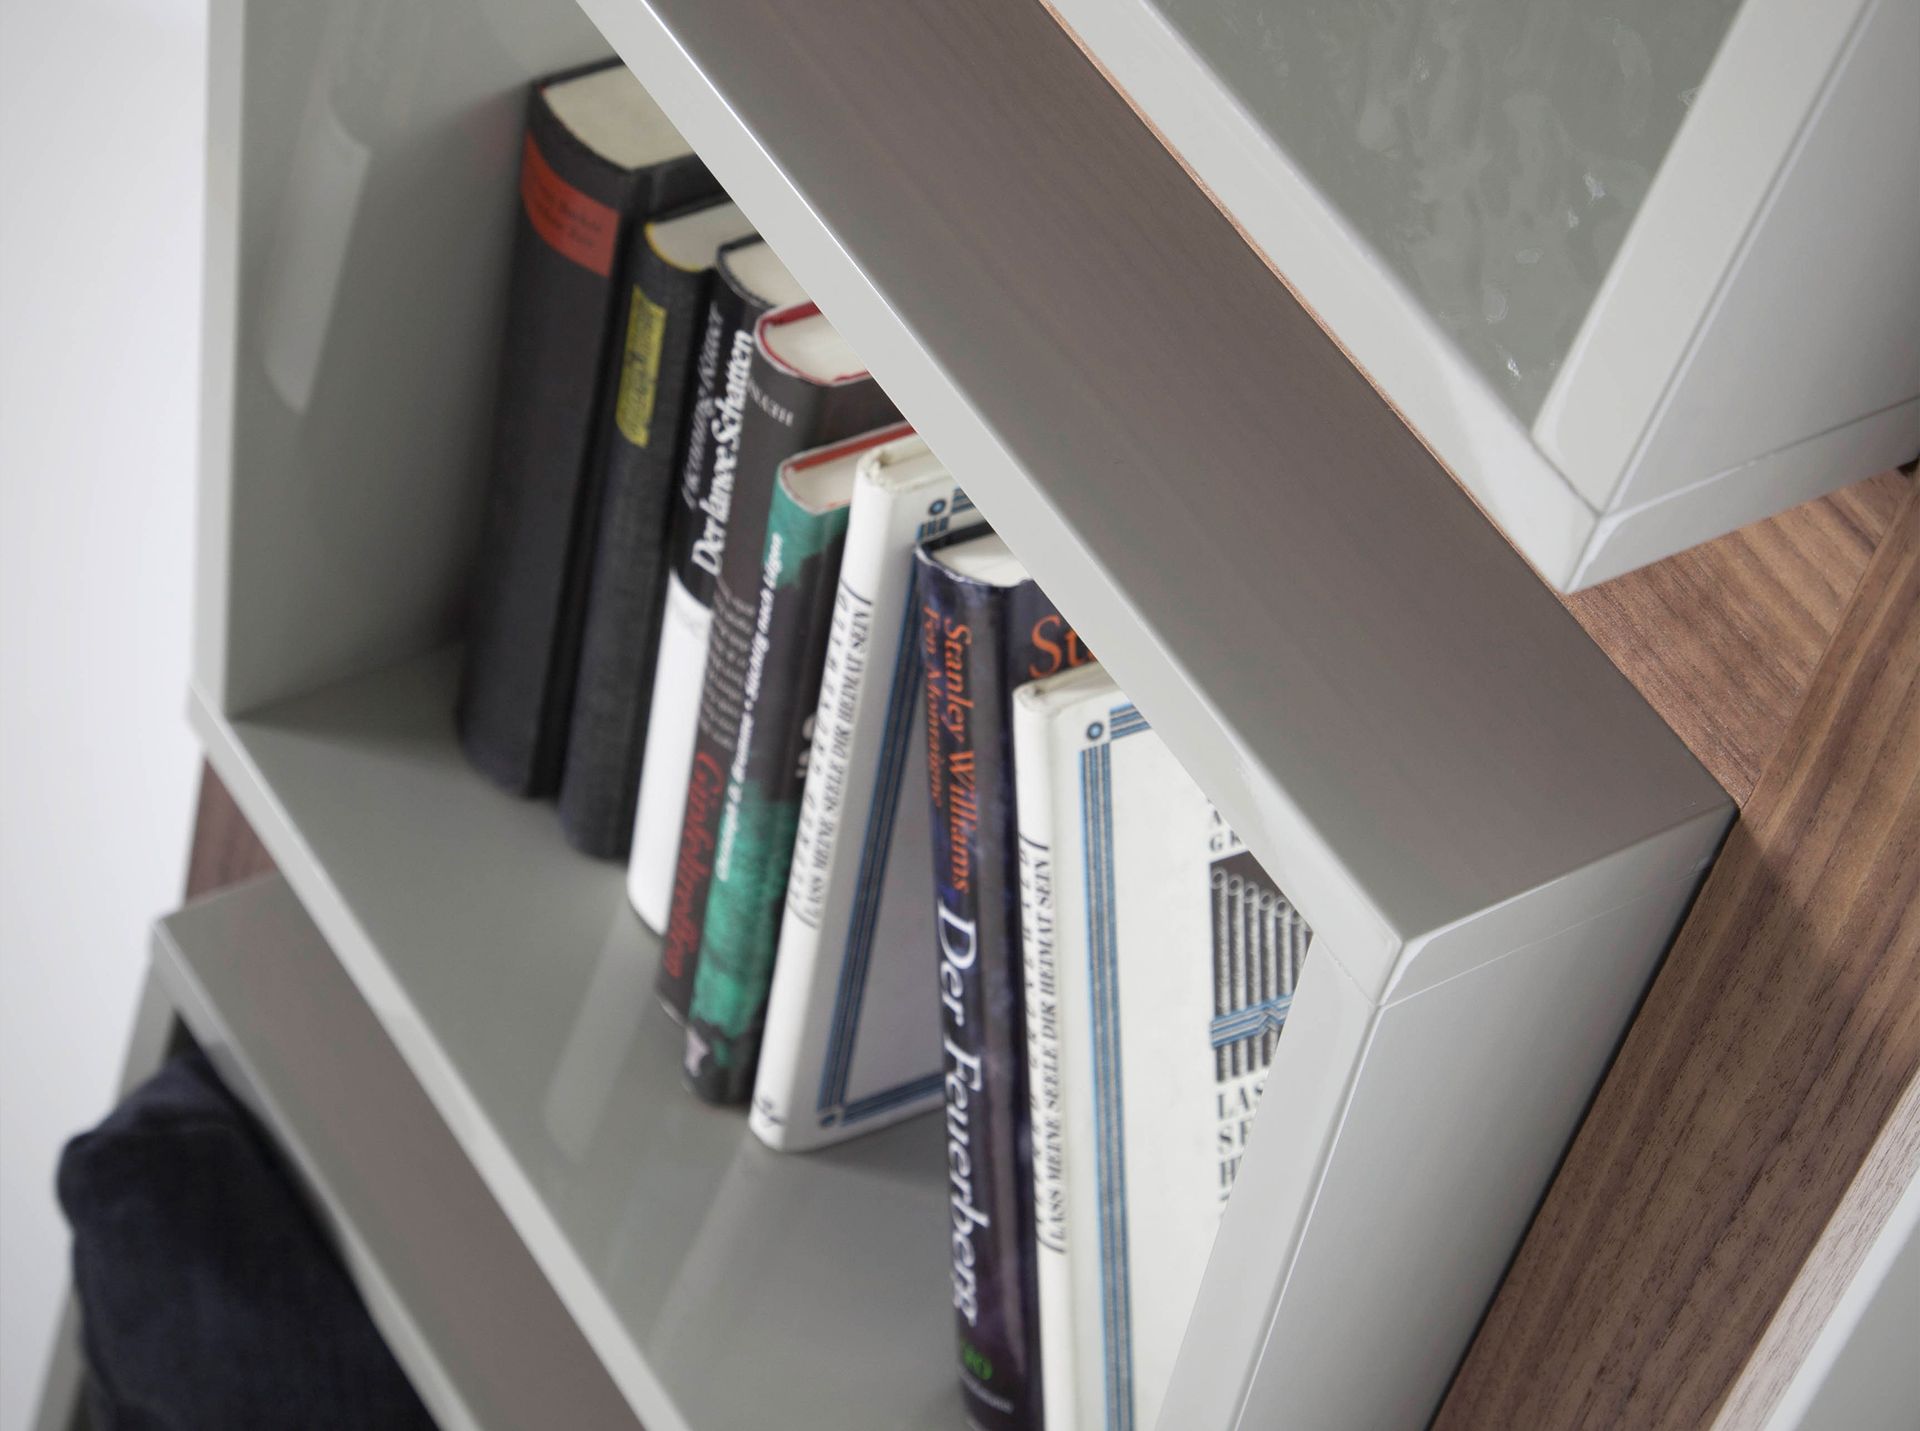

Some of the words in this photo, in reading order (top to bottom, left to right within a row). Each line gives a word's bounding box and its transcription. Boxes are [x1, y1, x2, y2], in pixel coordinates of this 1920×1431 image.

[691, 515, 727, 576] Der
[710, 329, 753, 451] Schatten
[941, 617, 975, 743] Stanley
[1028, 614, 1097, 679] St
[948, 751, 977, 896] Williams
[1034, 861, 1052, 909] SEIN
[938, 898, 977, 1027] Der
[1037, 914, 1056, 996] HEIMAT
[944, 1036, 990, 1328] Feuerberg
